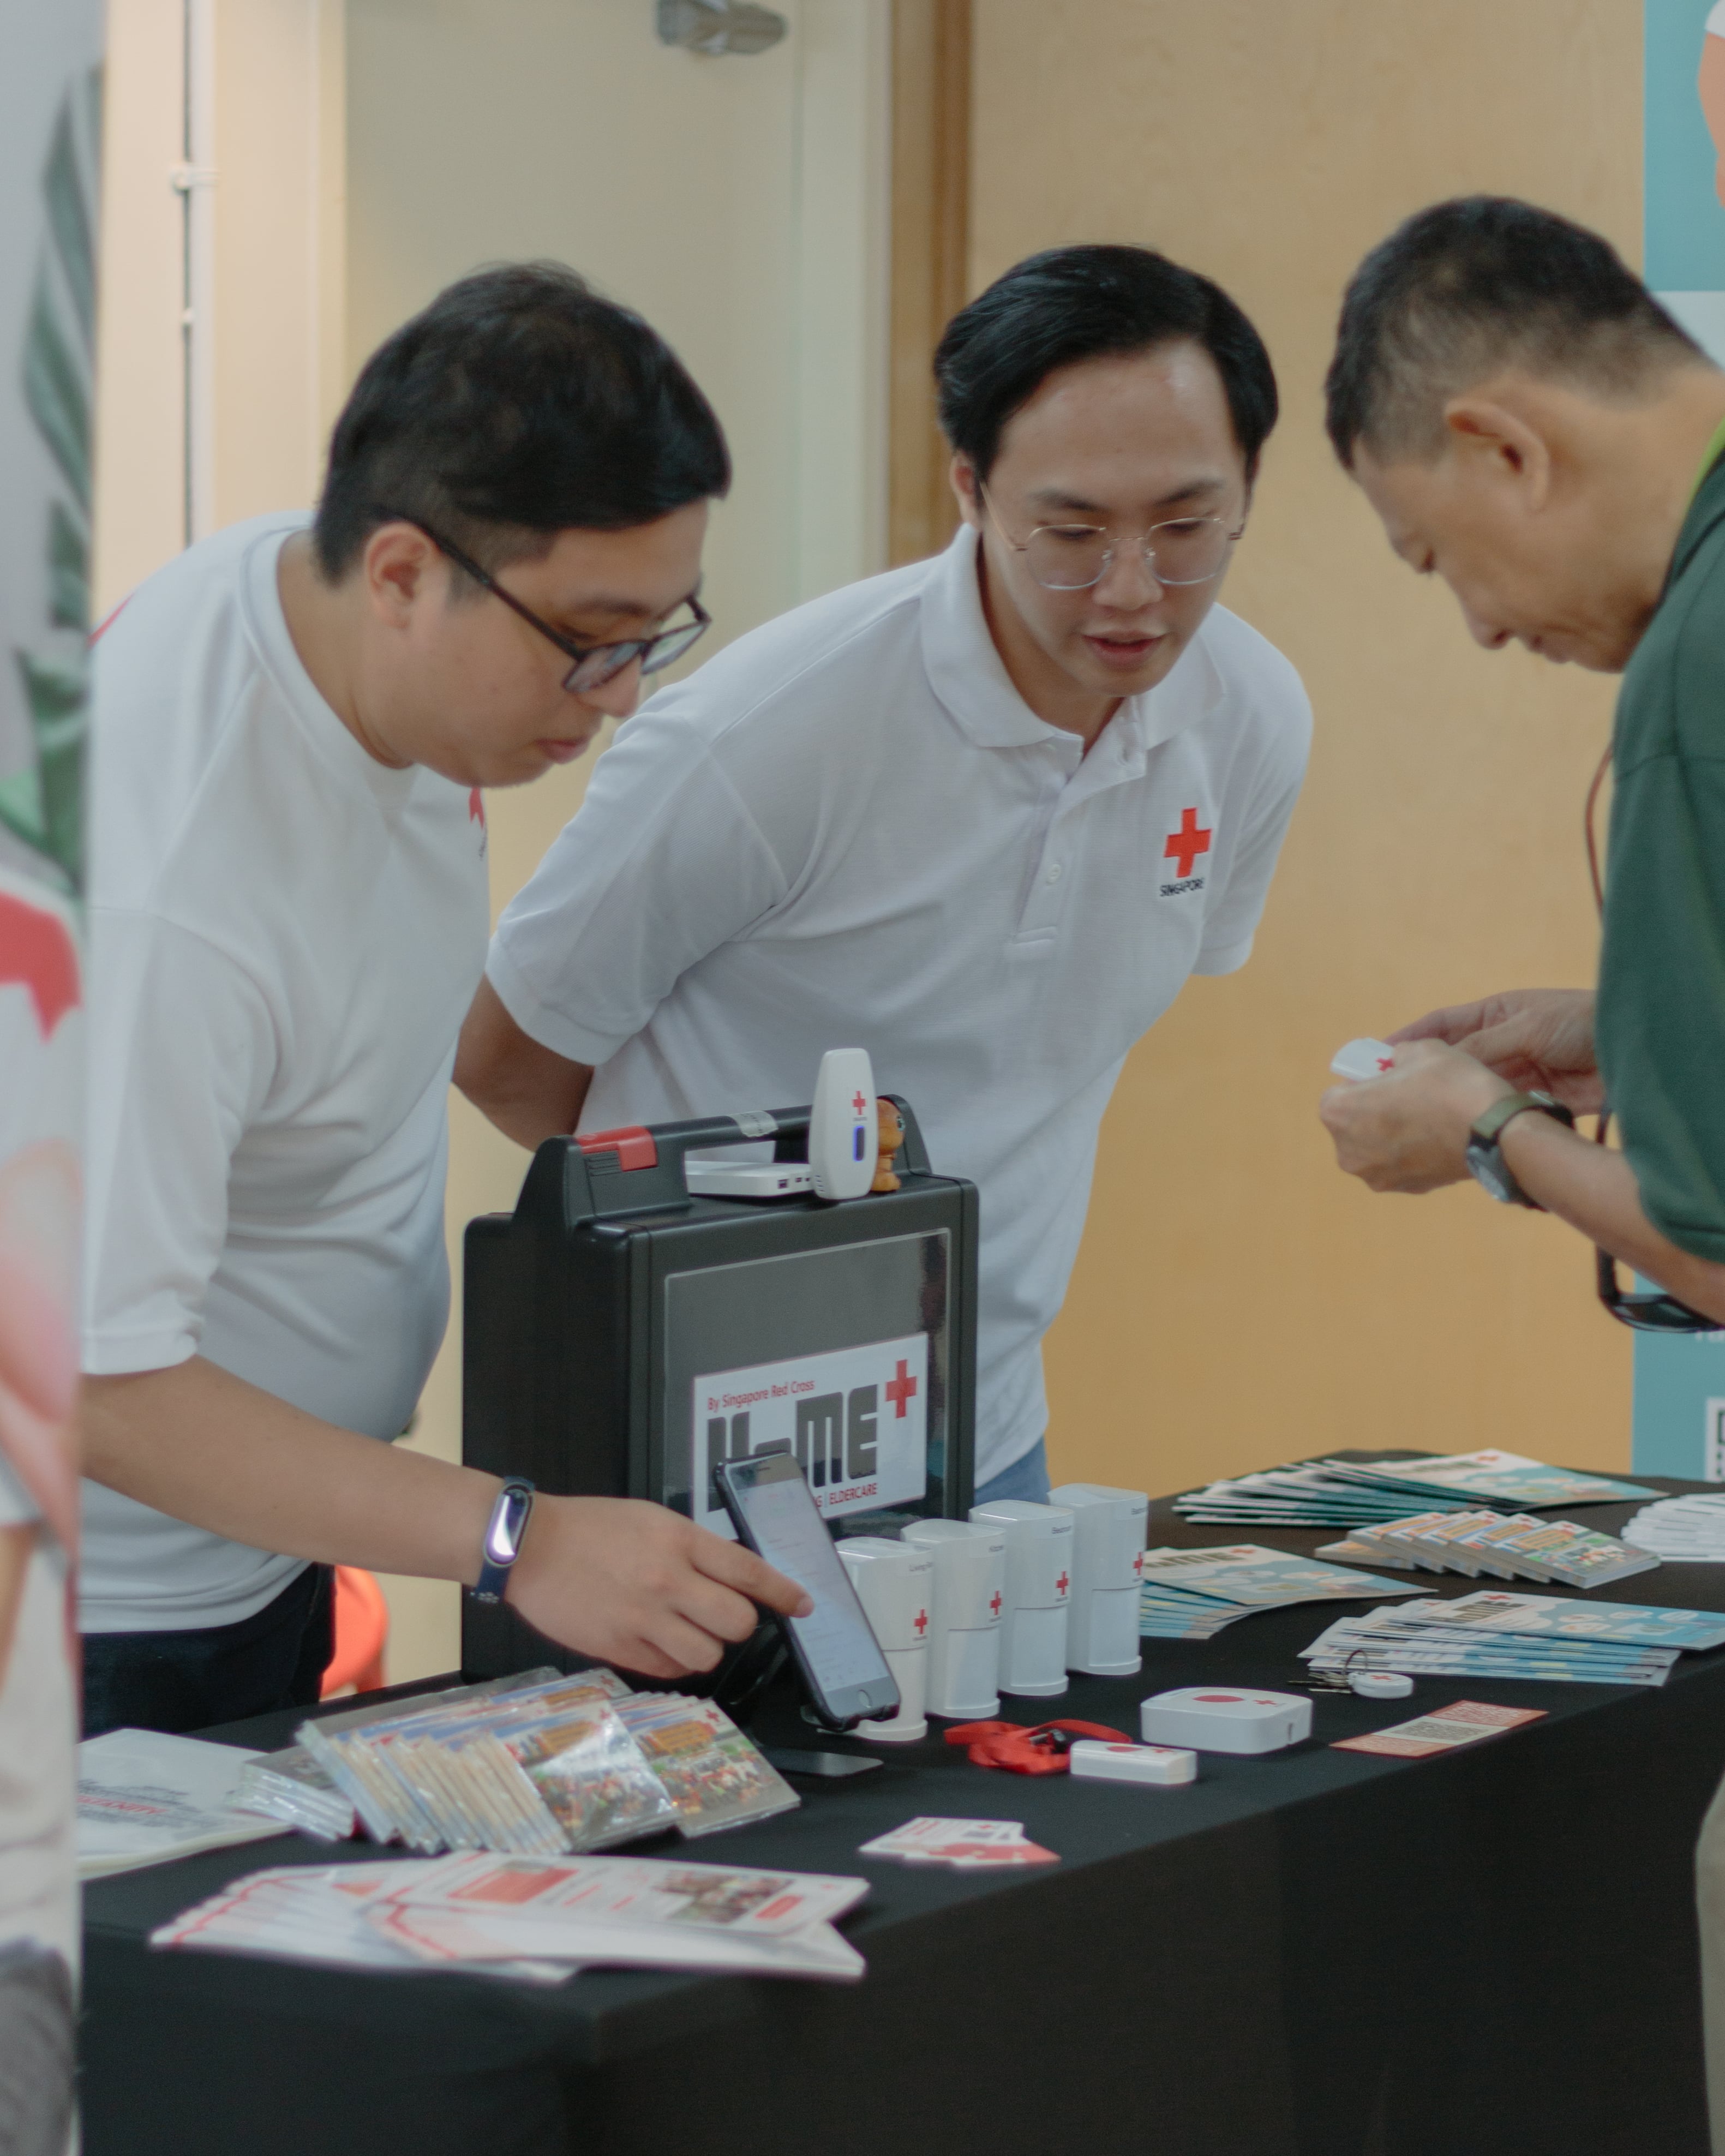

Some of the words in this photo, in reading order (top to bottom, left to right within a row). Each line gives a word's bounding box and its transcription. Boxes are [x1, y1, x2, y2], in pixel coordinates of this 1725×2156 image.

[708, 1397, 719, 1412] By
[722, 1393, 768, 1409] Singapore
[771, 1382, 788, 1397] Red
[791, 1381, 814, 1393] Cross
[829, 1483, 878, 1505] ELDERCARE
